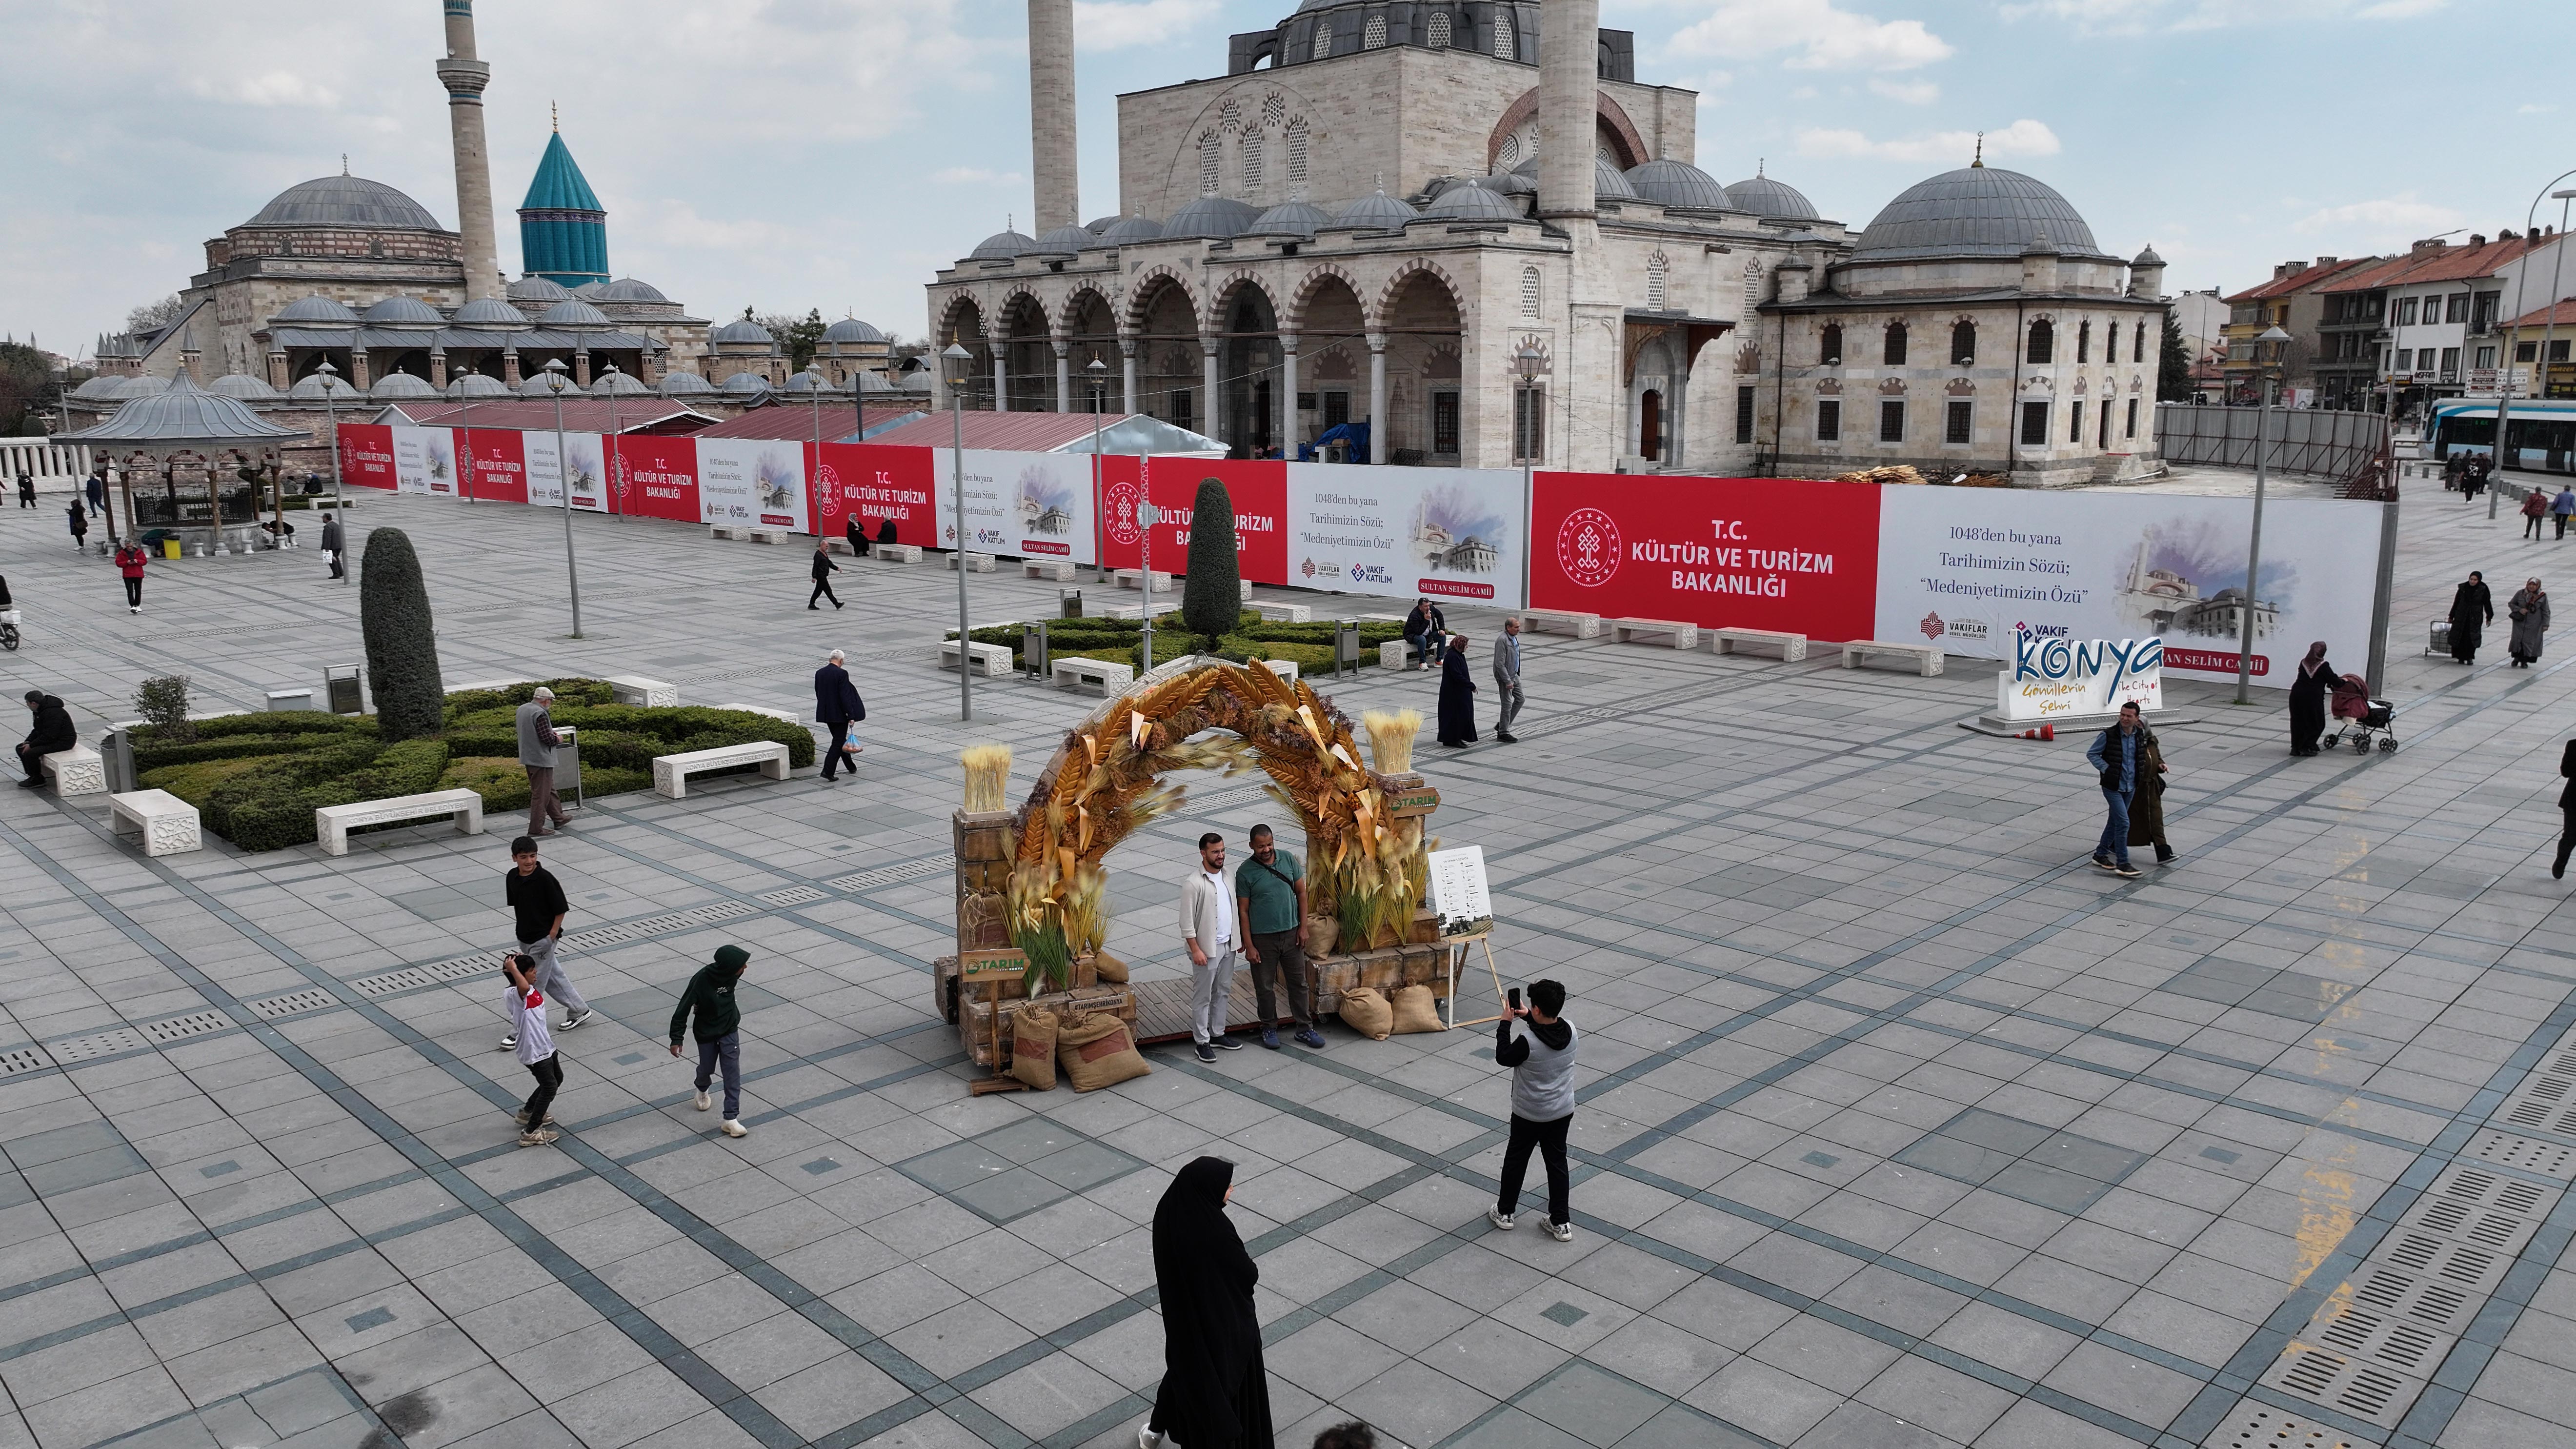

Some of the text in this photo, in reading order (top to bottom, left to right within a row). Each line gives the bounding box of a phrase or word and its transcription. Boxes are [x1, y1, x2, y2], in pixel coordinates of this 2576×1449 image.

[357, 450, 371, 461] KÜLTÜR
[376, 453, 392, 463] TURİZM
[492, 449, 502, 458] T.C.
[365, 463, 385, 473] BAKANLIĞI
[476, 459, 521, 472] KÜLTÜR VE TURİZM
[655, 458, 667, 470] T.C.
[486, 473, 513, 484] BAKANLIĞI
[634, 469, 692, 486] KÜLTÜR VE TURİZM
[708, 471, 730, 480] Tarihimizin
[876, 471, 891, 484] T.C.
[974, 473, 980, 482] bu
[981, 476, 993, 484] yana
[646, 486, 681, 500] BAKANLIĞI
[845, 485, 926, 504] KÜLTÜR VE TURİZM
[949, 488, 998, 501] Taimizin Sözü;
[1315, 493, 1378, 508] 1048’den bu yana
[862, 504, 909, 521] BAKANLIĞI
[944, 504, 990, 516] “Mediyetimizin
[1157, 505, 1194, 526] ÜLTÜ
[1234, 512, 1273, 532] URİZM
[1310, 512, 1384, 529] Tarihimizin Sözü;
[1711, 520, 1748, 541] T.C.
[1950, 526, 2062, 547] 1048’den bu yana
[1300, 532, 1394, 550] “Medeniyetimizin Özü”
[1023, 542, 1068, 554] SULTAN SELİM CAMİİ
[1631, 539, 1833, 574] KÜLTÜR VE TURİZM
[1366, 565, 1385, 574] VAKIF
[1939, 552, 2071, 577] Tarihimizin Sözü;
[1366, 574, 1392, 584] KATILIM
[1672, 570, 1787, 598] BAKANLIĞI
[1421, 583, 1492, 596] SULTAN SELİM CAMİİ
[1920, 578, 2089, 604] “Medeniyetimizin Özü”
[1950, 623, 1987, 633] VAKIFLAR
[2035, 624, 2069, 637] VAKIF
[2185, 654, 2222, 667] SELİM
[2226, 659, 2264, 671] CAİİ
[2022, 682, 2086, 699] Gönüllerin
[2118, 681, 2131, 691] The
[2132, 681, 2149, 694] City
[2039, 700, 2071, 715] Şehri
[707, 756, 744, 768] BÜYÜKŞEHİR
[744, 750, 777, 762] BELEDİYESİ
[1402, 796, 1436, 806] TARIM
[347, 800, 467, 825] KONYA BÜYÜKŞEHİR BELEDİYESİ
[980, 958, 1024, 969] TARIM
[1074, 998, 1123, 1010] #TARIMŞEHRİKONYA
